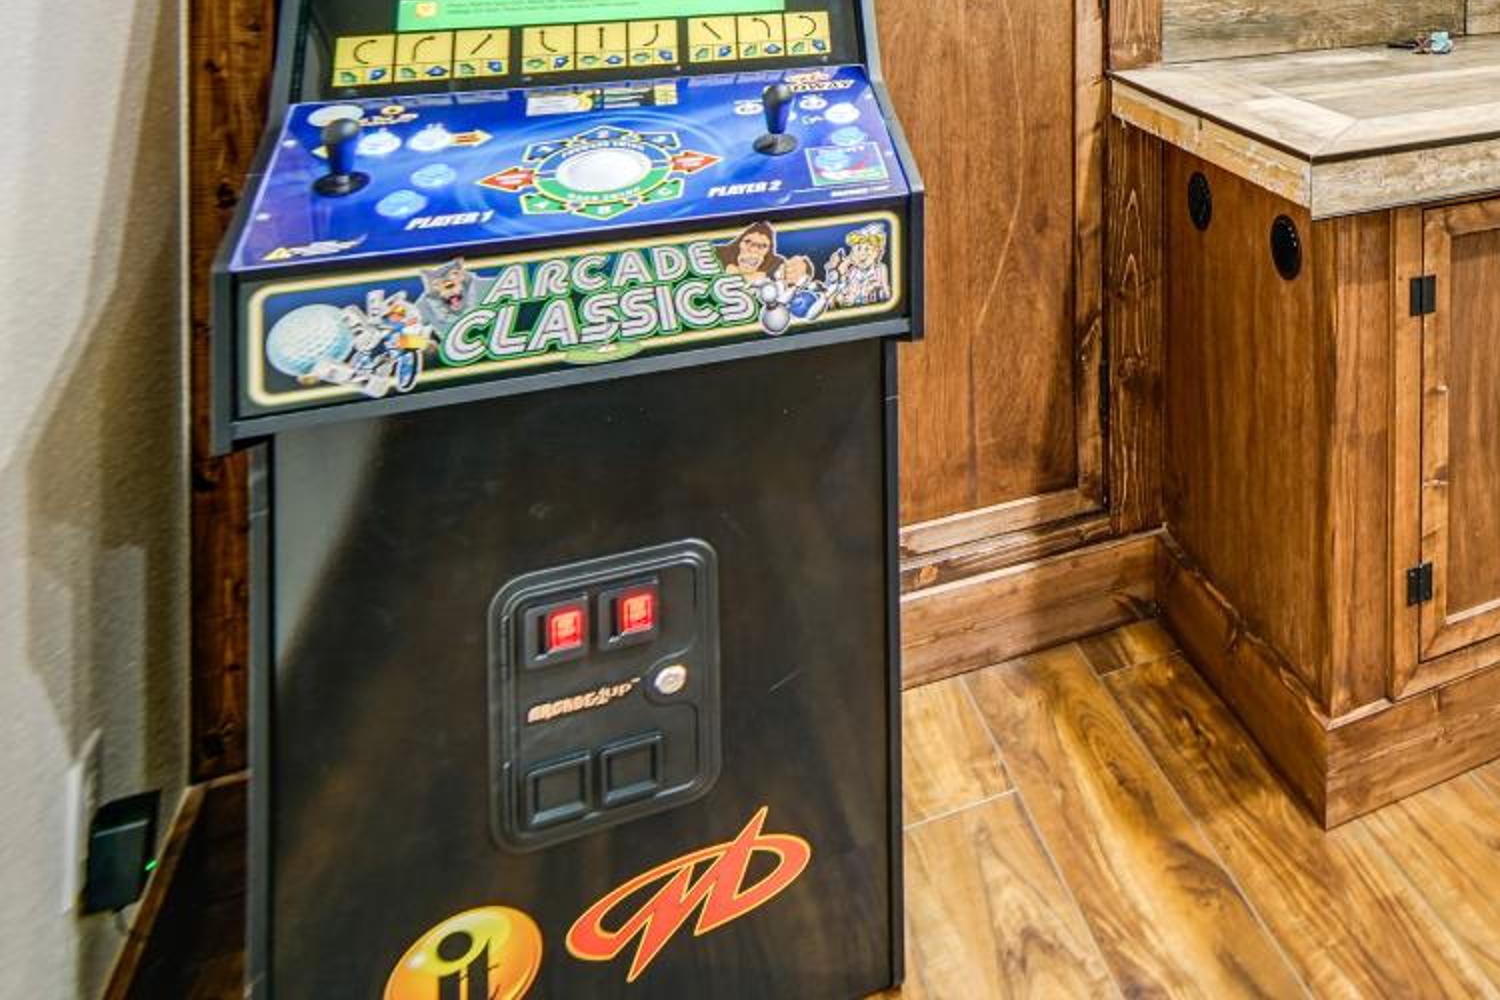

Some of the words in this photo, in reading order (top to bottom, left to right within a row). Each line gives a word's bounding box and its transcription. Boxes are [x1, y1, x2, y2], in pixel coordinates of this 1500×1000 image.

[708, 182, 767, 198] PLAYER
[768, 180, 784, 192] 2
[404, 212, 478, 231] PLAYER
[479, 209, 496, 223] 1
[481, 241, 722, 305] ARCADE
[442, 276, 755, 362] CLASSICS
